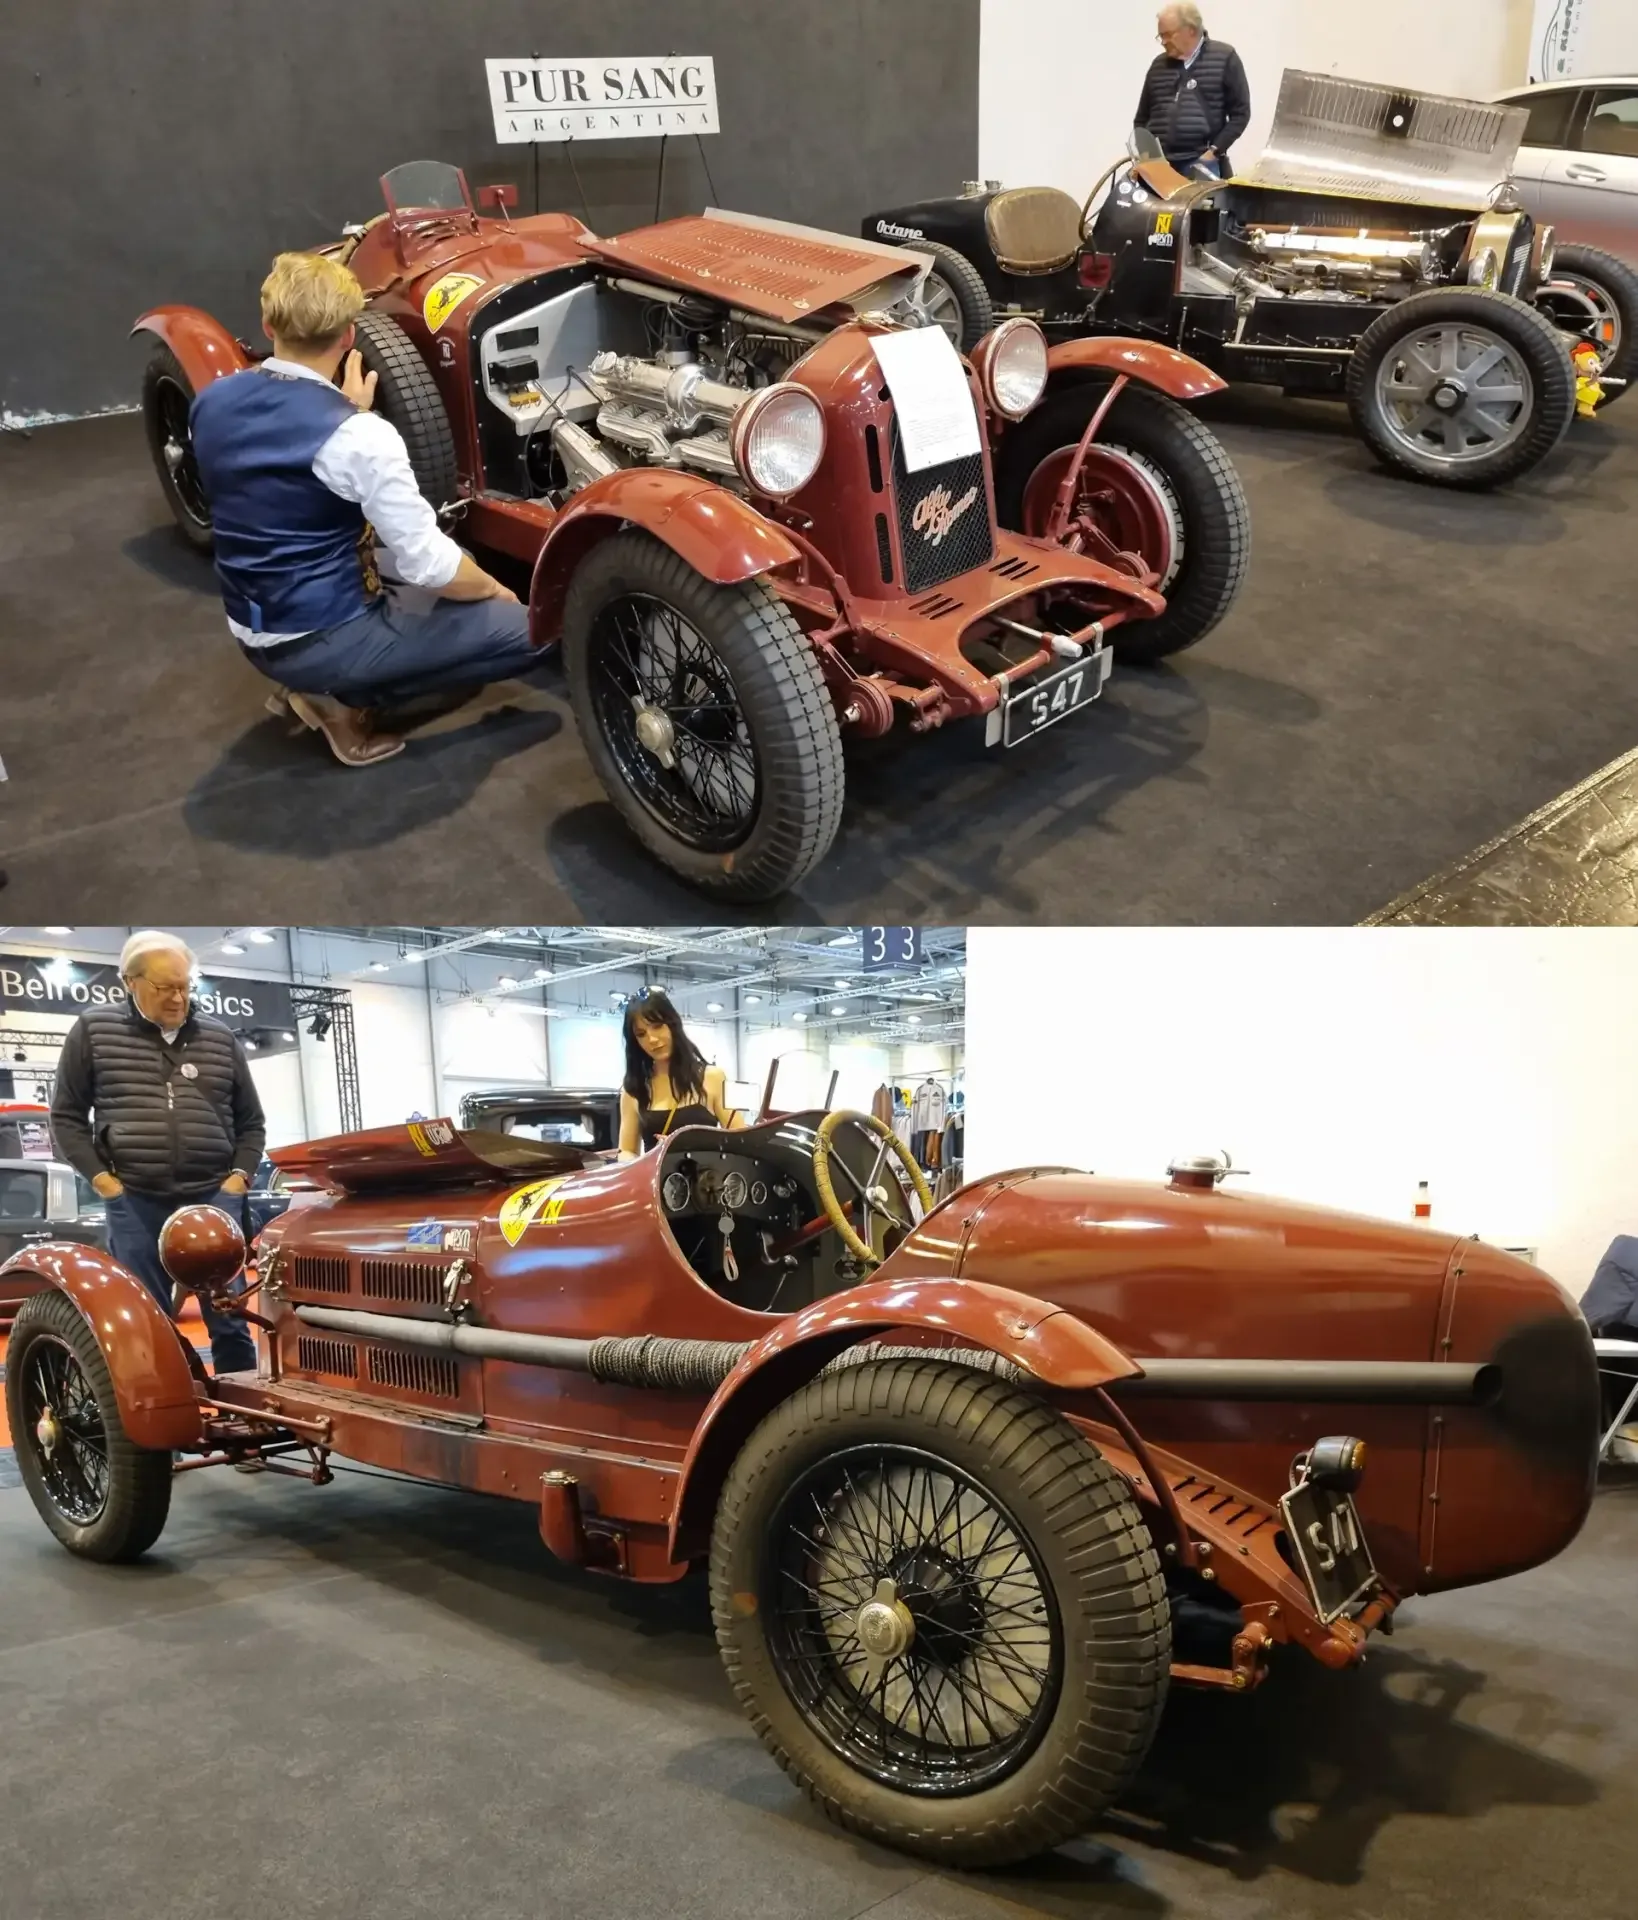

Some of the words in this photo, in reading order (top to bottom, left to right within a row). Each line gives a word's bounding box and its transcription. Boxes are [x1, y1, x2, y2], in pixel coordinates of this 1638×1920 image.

[500, 69, 591, 103] PUR
[603, 66, 705, 101] SANG
[507, 112, 709, 133] ARGENTINA
[876, 219, 926, 241] Octane
[1030, 670, 1084, 726] S47
[0, 968, 126, 1005] Belrose
